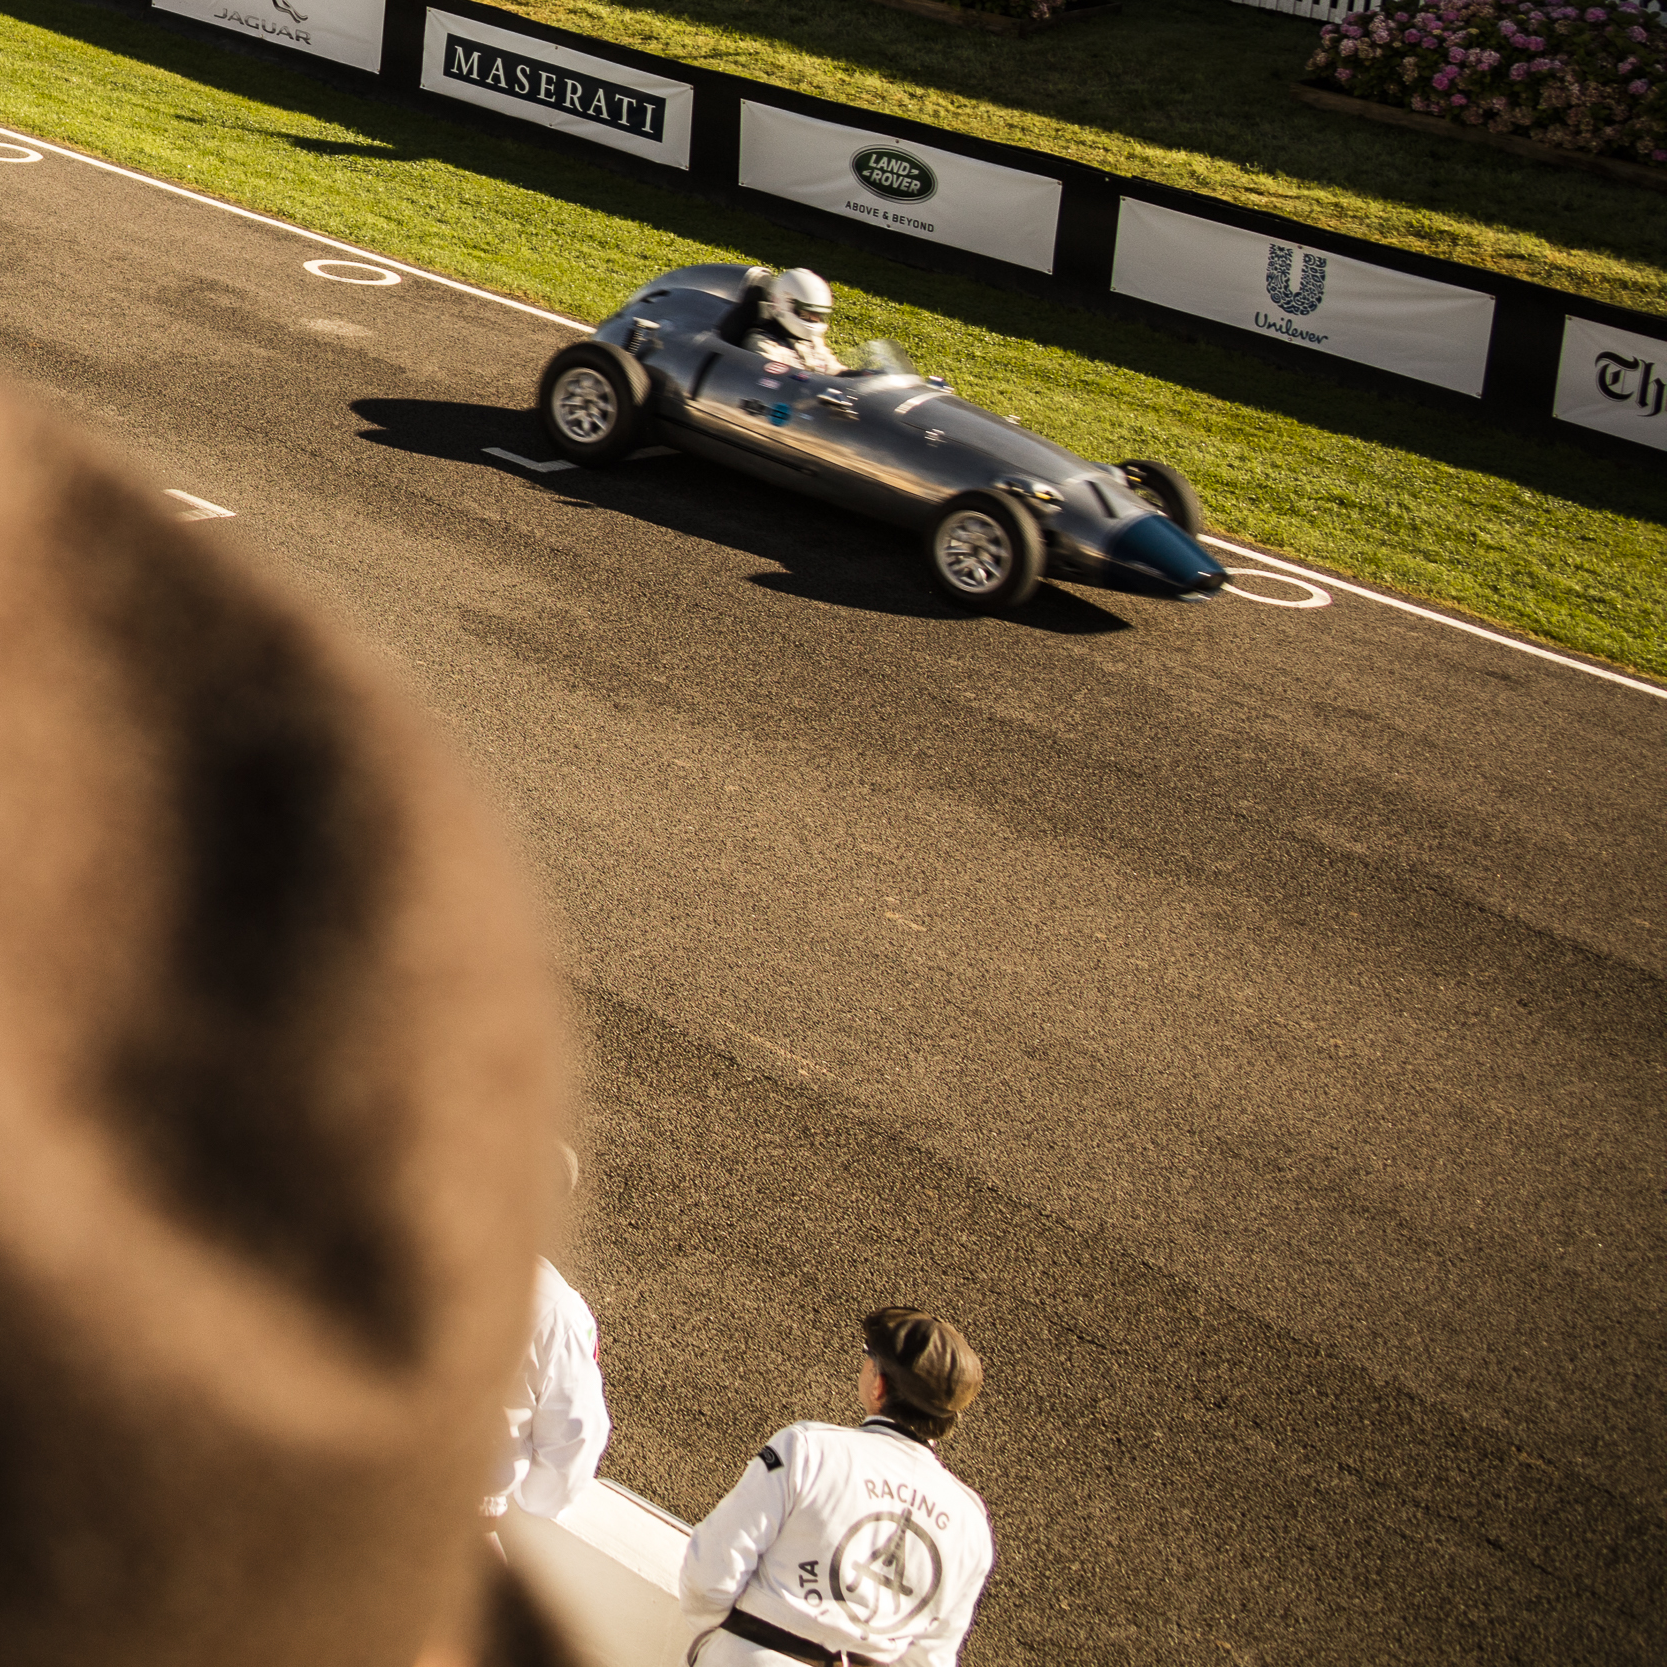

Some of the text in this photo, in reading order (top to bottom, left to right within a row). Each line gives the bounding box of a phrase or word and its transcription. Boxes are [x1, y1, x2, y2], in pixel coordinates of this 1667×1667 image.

[213, 6, 313, 47] JAGUAR
[449, 44, 657, 135] MASERATI
[866, 154, 912, 176] LAND
[869, 168, 922, 194] ROVER
[845, 199, 935, 233] ABOVE & BEYOND
[1254, 309, 1329, 345] Unilever
[1595, 350, 1667, 417] Th
[863, 1478, 951, 1531] RACING
[798, 1560, 824, 1620] OTA
